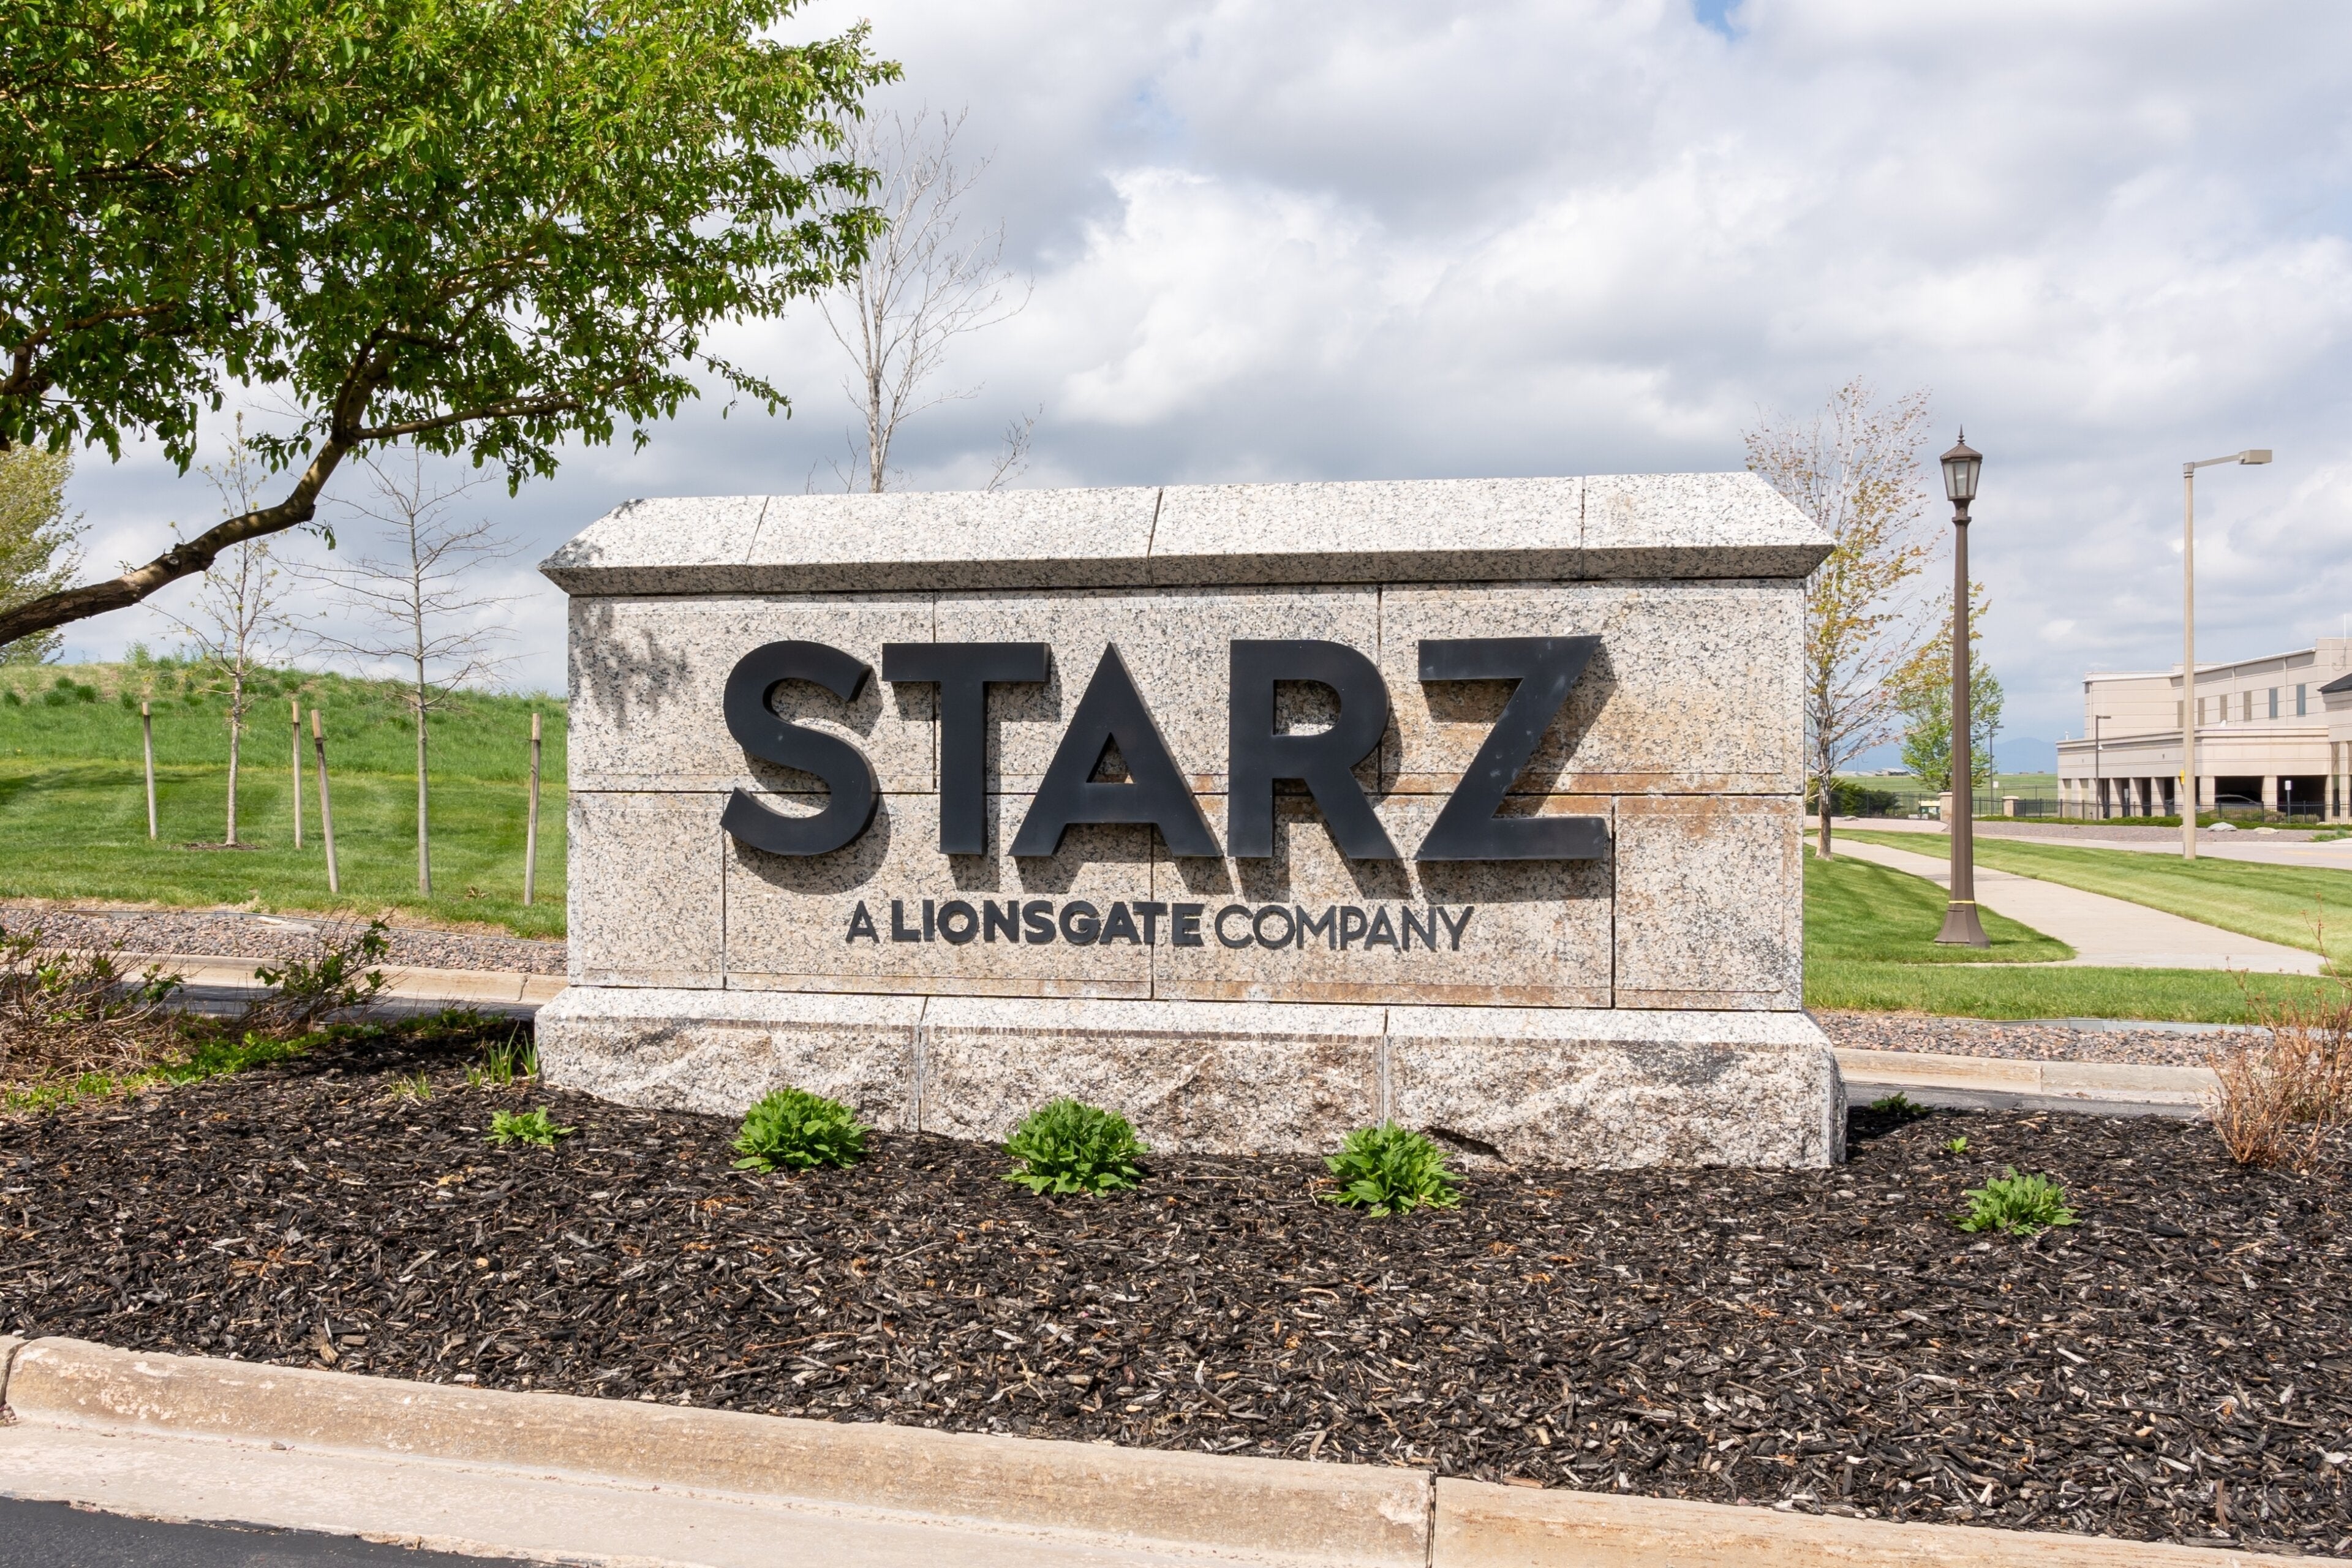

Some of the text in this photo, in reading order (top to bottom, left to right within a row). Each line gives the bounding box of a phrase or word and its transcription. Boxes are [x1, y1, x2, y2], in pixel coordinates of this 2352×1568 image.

[721, 635, 1610, 862] STARZ
[846, 899, 1475, 951] A LIONSGATE COMPANY
